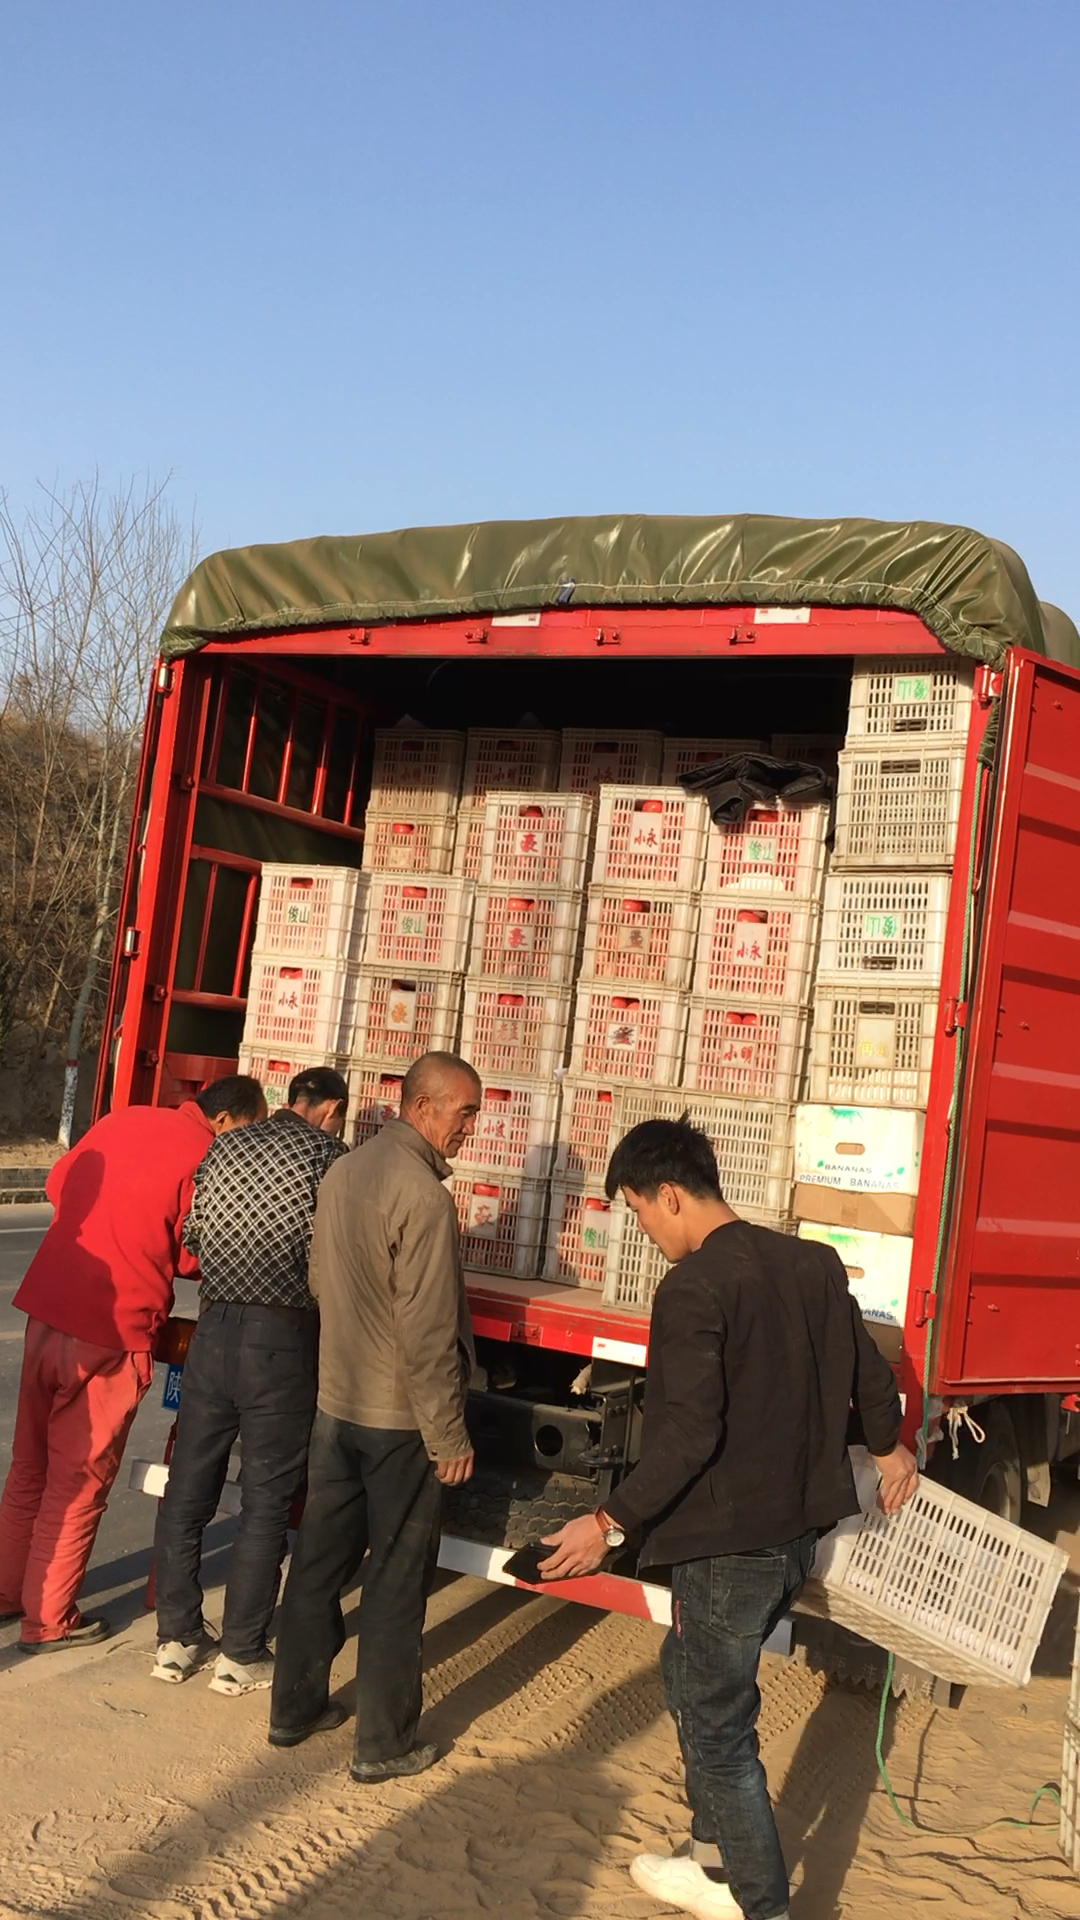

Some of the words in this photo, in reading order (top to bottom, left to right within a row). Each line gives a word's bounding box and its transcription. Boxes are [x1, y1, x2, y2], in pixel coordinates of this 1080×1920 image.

[287, 905, 310, 924] 俊山
[401, 915, 424, 934] 俊山
[824, 1163, 873, 1174] BANANAS
[799, 1174, 842, 1186] PREMIUM
[850, 1177, 901, 1190] BANANAS
[583, 1227, 610, 1250] 俊山
